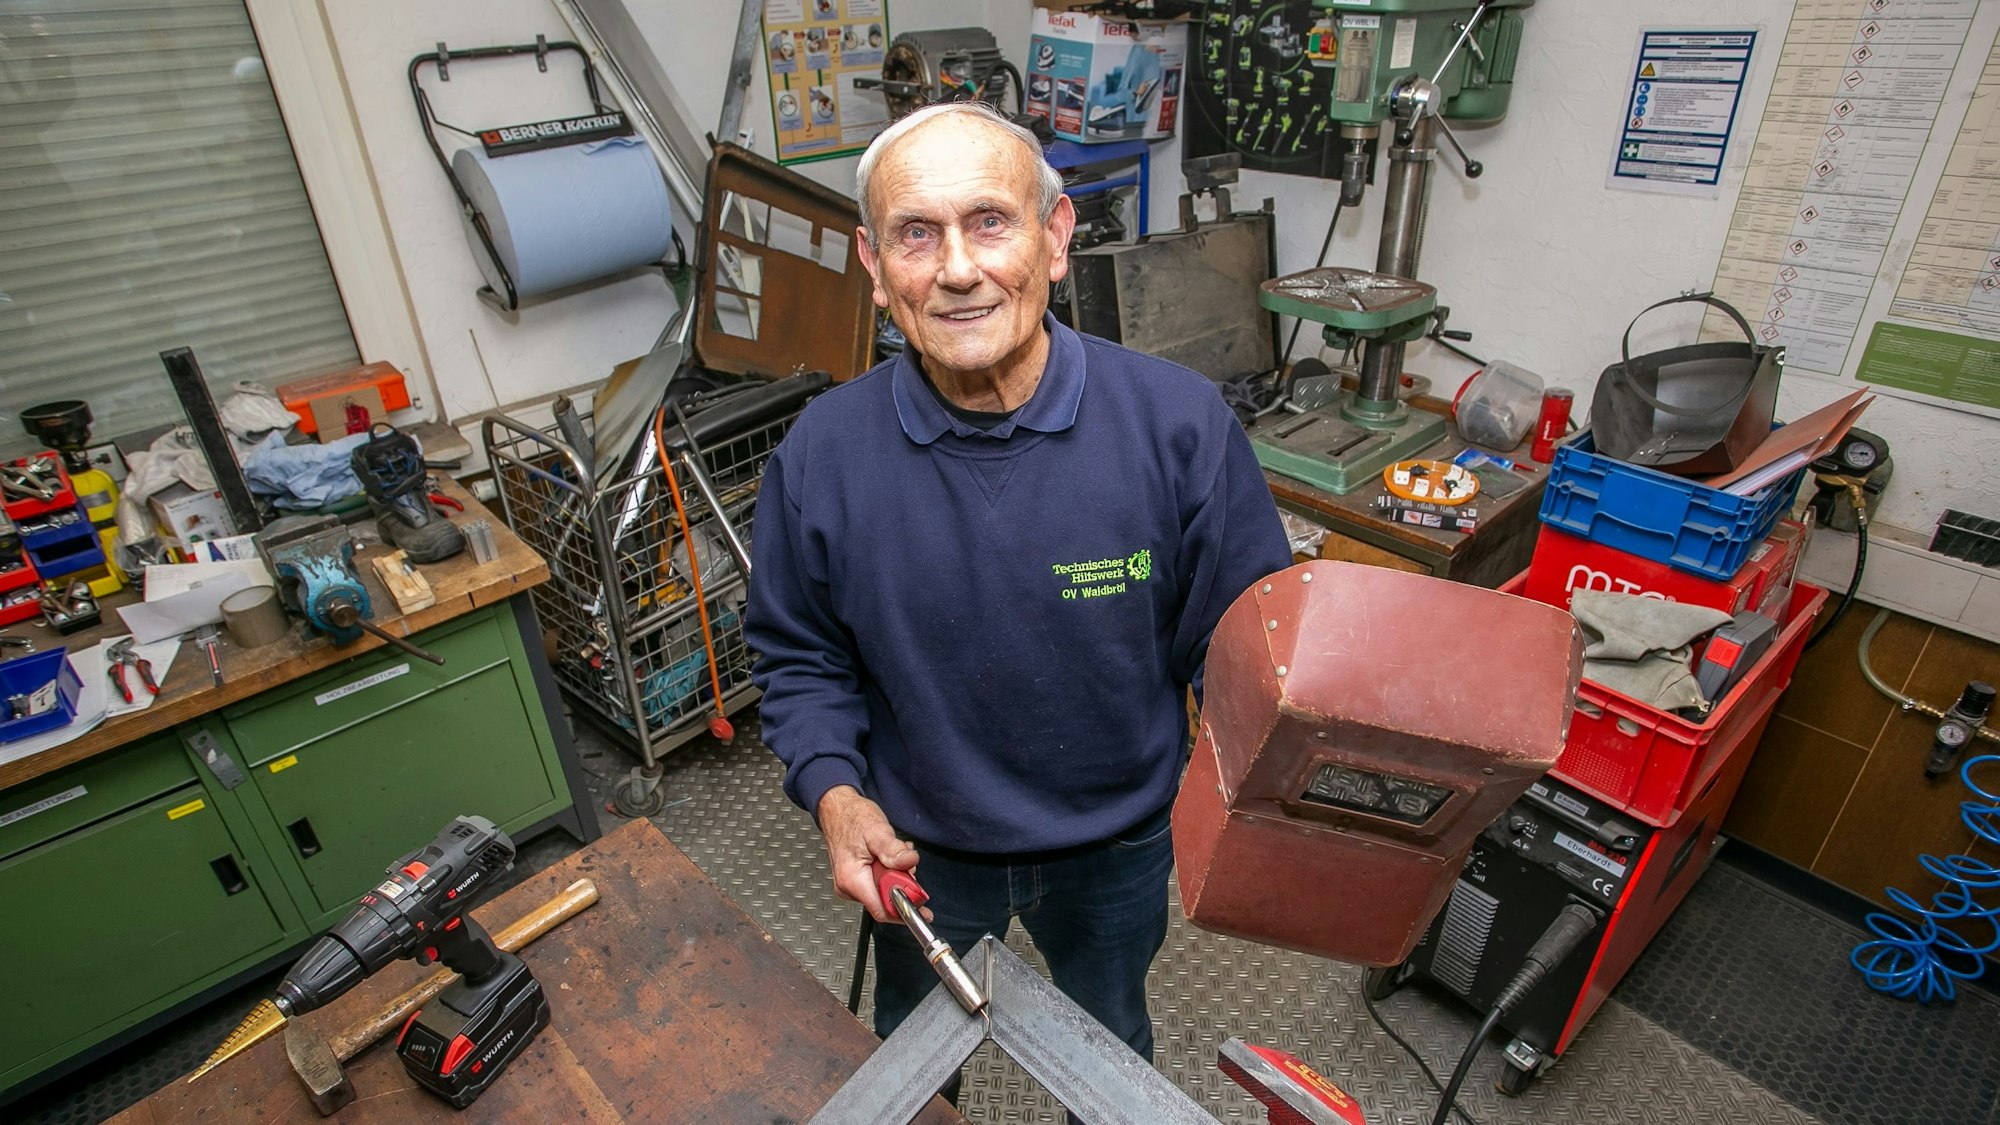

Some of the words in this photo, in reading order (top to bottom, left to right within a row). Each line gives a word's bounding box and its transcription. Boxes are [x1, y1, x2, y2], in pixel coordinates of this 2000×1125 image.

[1102, 22, 1131, 36] Tefa
[498, 121, 565, 142] BERNER
[564, 114, 621, 132] KATRIN
[1052, 558, 1124, 574] Technisches
[1071, 568, 1125, 583] Hilfswerk
[1061, 588, 1077, 599] OV
[1081, 582, 1126, 598] Waldbröl
[326, 668, 401, 700] HOLZBEARBEITUNG
[0, 792, 74, 824] BEARBEITUNG
[1566, 839, 1612, 869] Eberhardt
